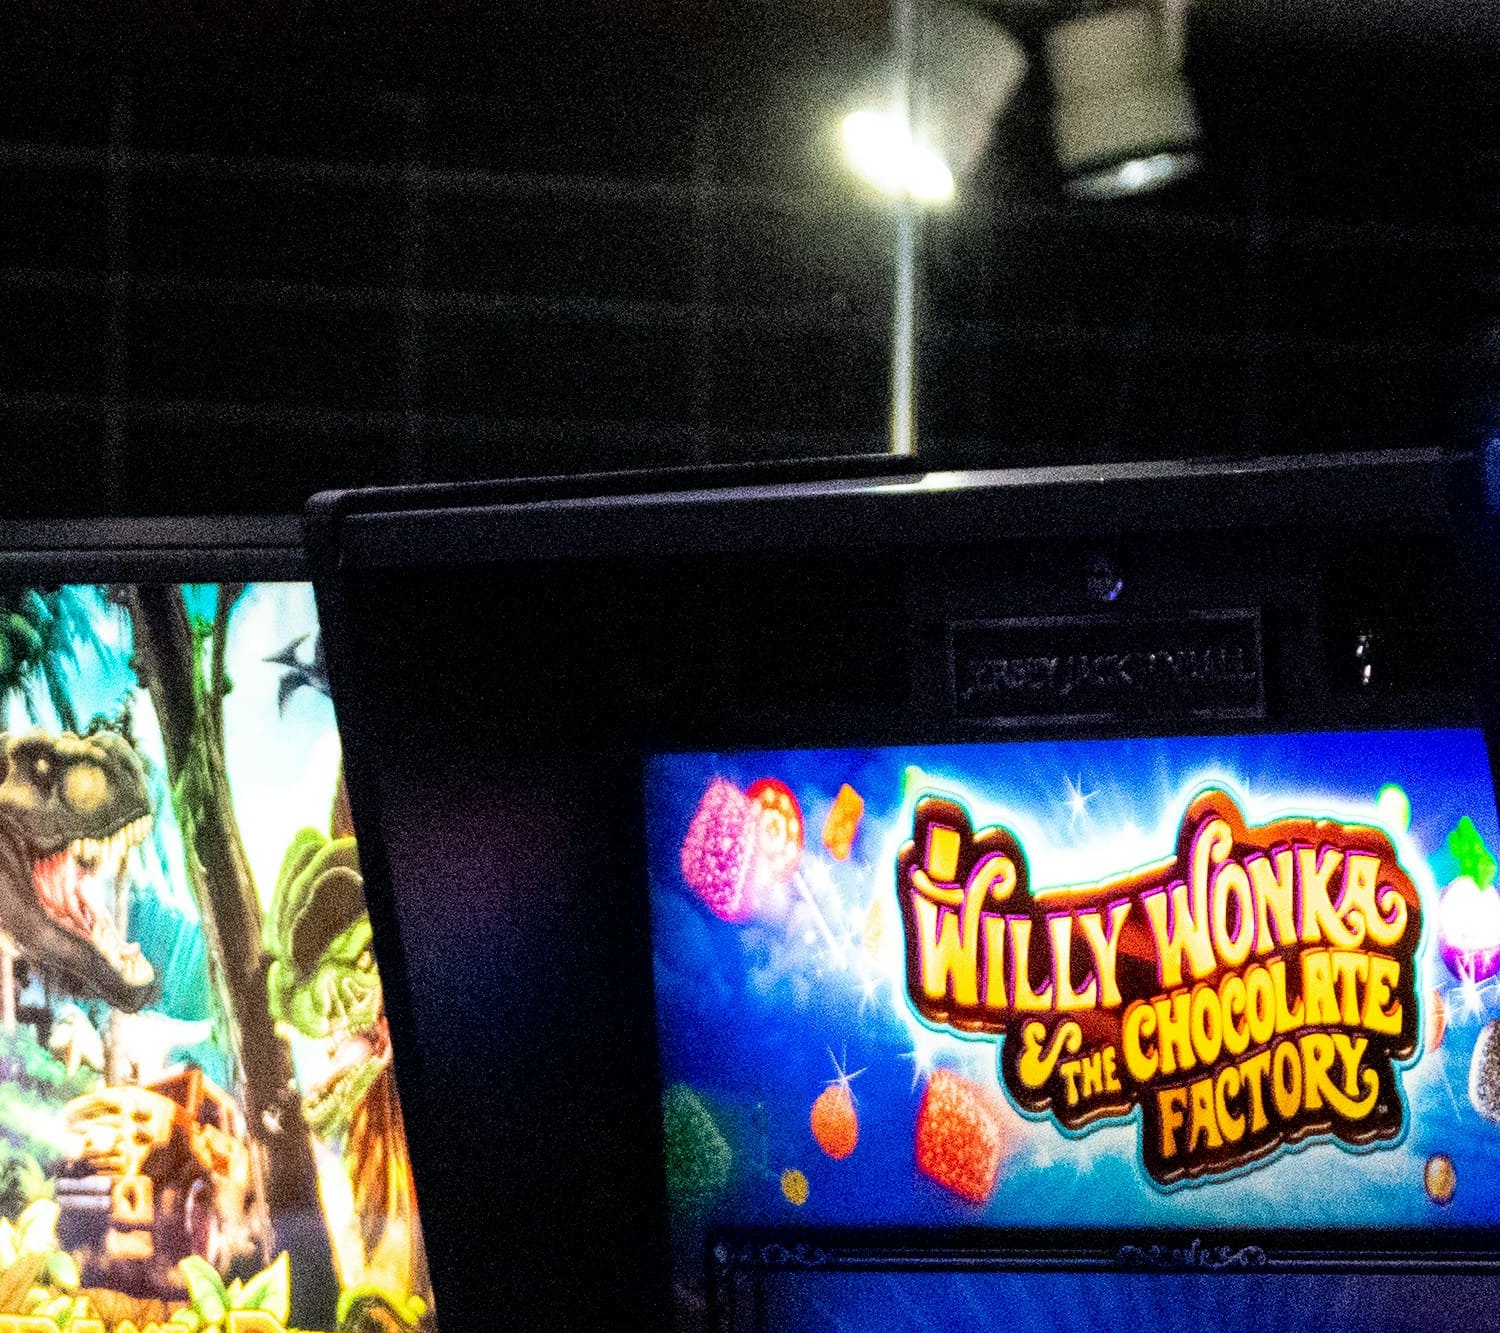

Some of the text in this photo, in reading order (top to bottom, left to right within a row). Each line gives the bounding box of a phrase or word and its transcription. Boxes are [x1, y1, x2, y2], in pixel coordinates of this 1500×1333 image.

[911, 814, 1410, 1012] WILLY WONKA
[1060, 1050, 1120, 1106] THE
[1120, 945, 1407, 1083] CHOCOLATE
[1158, 1036, 1381, 1159] FACTORY
